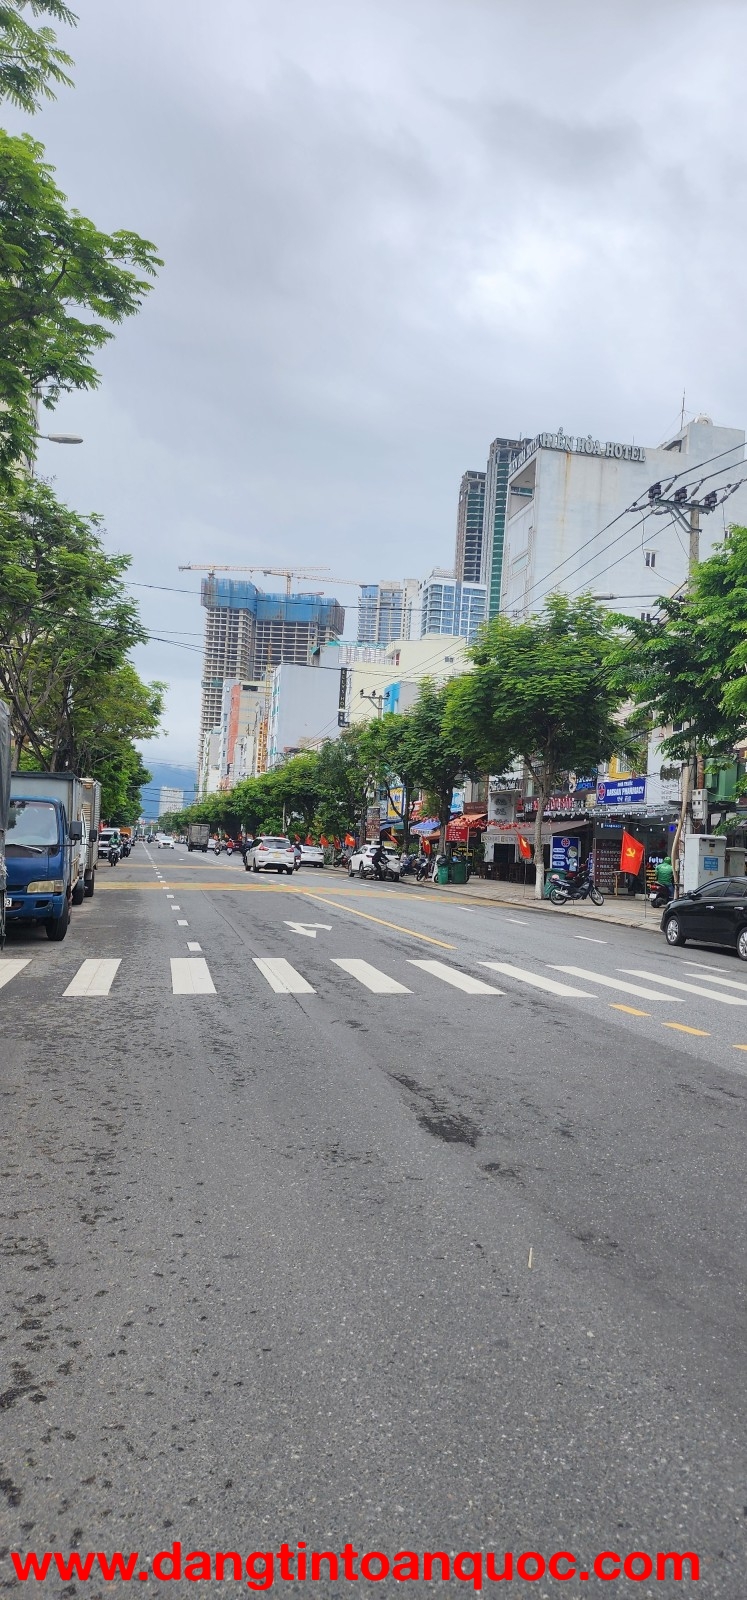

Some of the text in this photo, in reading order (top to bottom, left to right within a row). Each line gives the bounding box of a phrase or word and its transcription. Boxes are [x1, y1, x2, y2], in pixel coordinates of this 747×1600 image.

[576, 434, 602, 455] HÒA
[605, 442, 646, 462] HOTEL
[622, 786, 644, 796] PHARMACY
